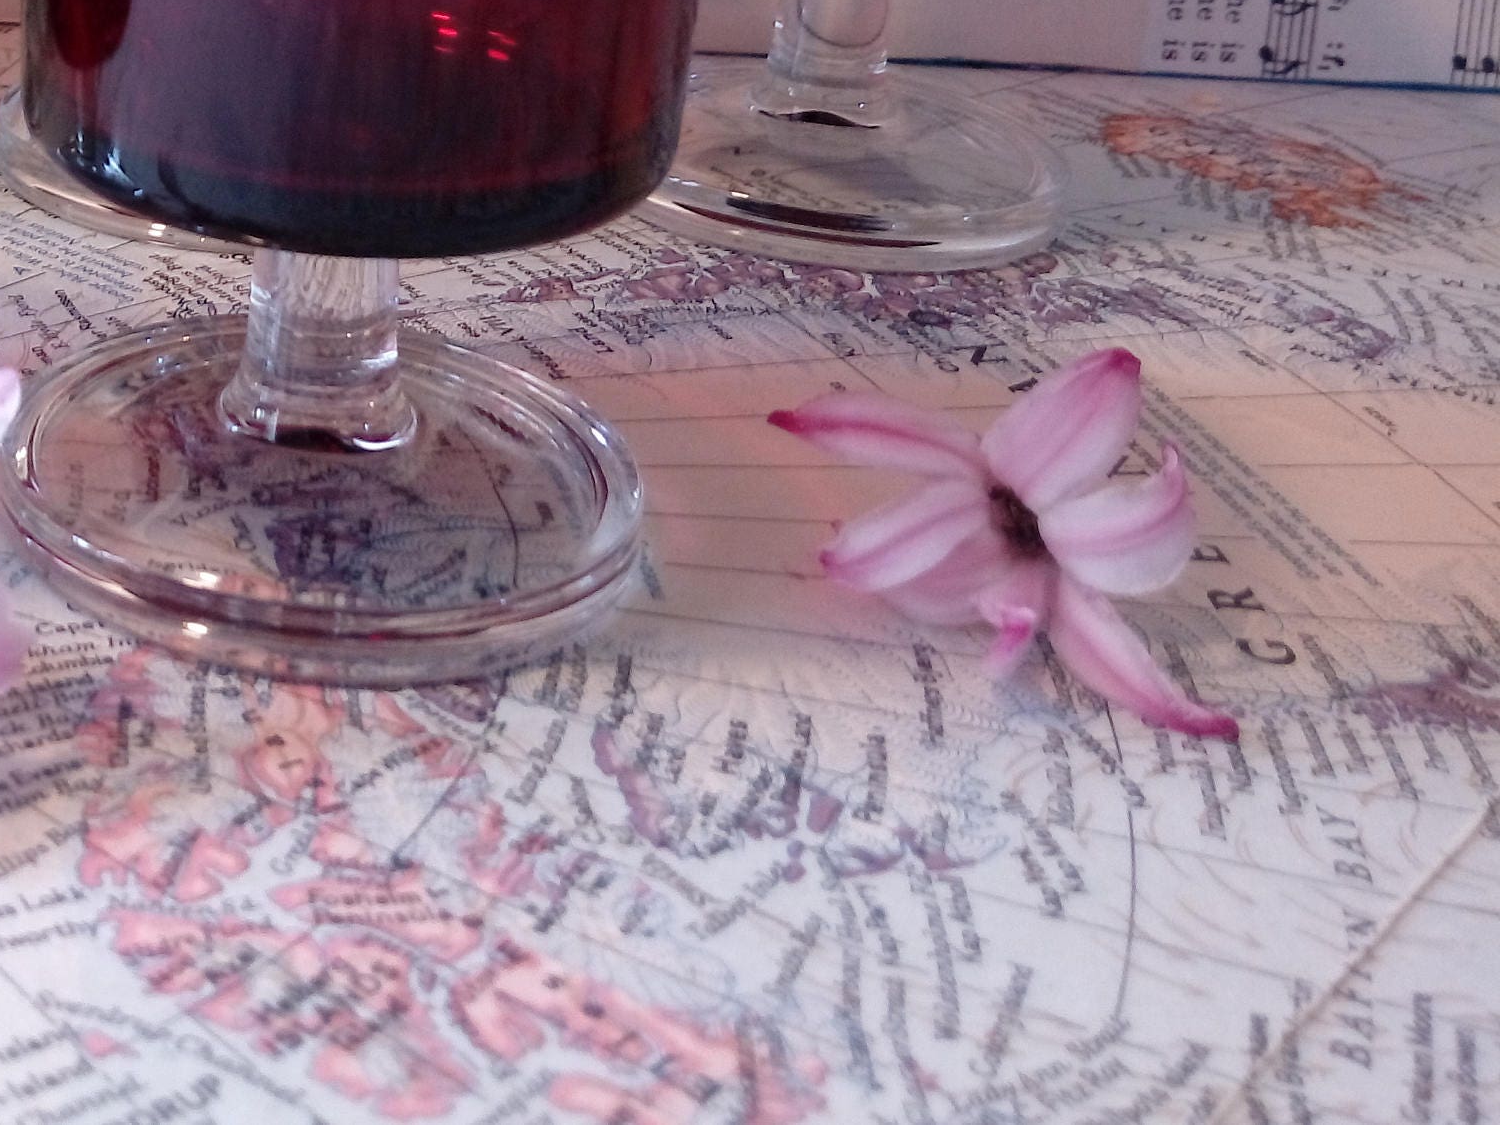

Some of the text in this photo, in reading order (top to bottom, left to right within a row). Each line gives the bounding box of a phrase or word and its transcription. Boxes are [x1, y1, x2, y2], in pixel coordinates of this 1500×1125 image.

[1161, 37, 1186, 62] is
[1191, 39, 1217, 63] is
[1219, 42, 1245, 63] is
